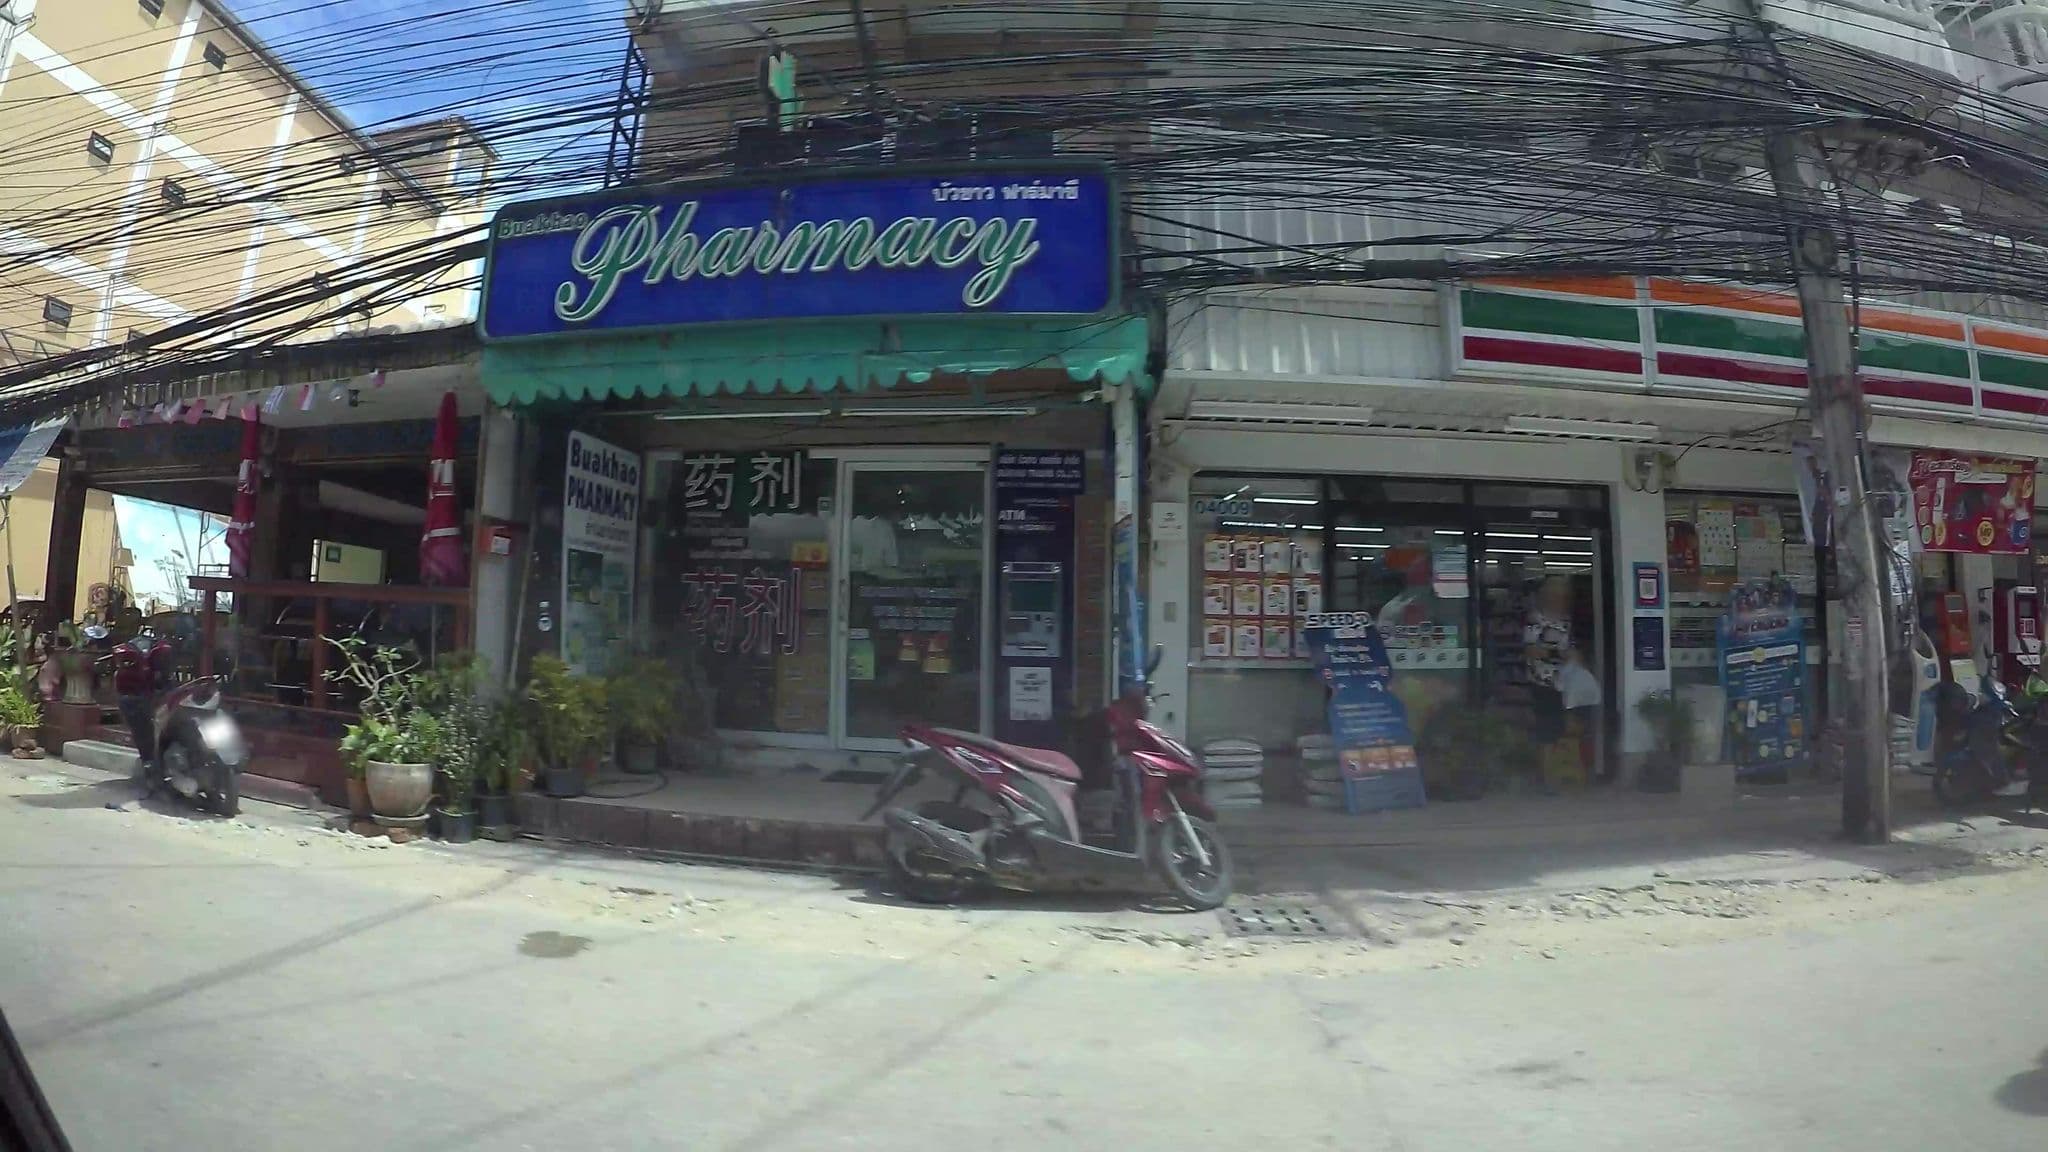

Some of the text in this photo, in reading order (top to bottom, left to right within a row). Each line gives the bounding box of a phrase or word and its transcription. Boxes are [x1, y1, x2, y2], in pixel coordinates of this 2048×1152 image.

[498, 212, 589, 239] Buakhao
[554, 200, 1041, 322] Pharmacy
[570, 437, 637, 487] Buakhao
[684, 451, 801, 510] 药剂
[567, 474, 639, 521] PHARMACY
[998, 508, 1026, 521] ATM
